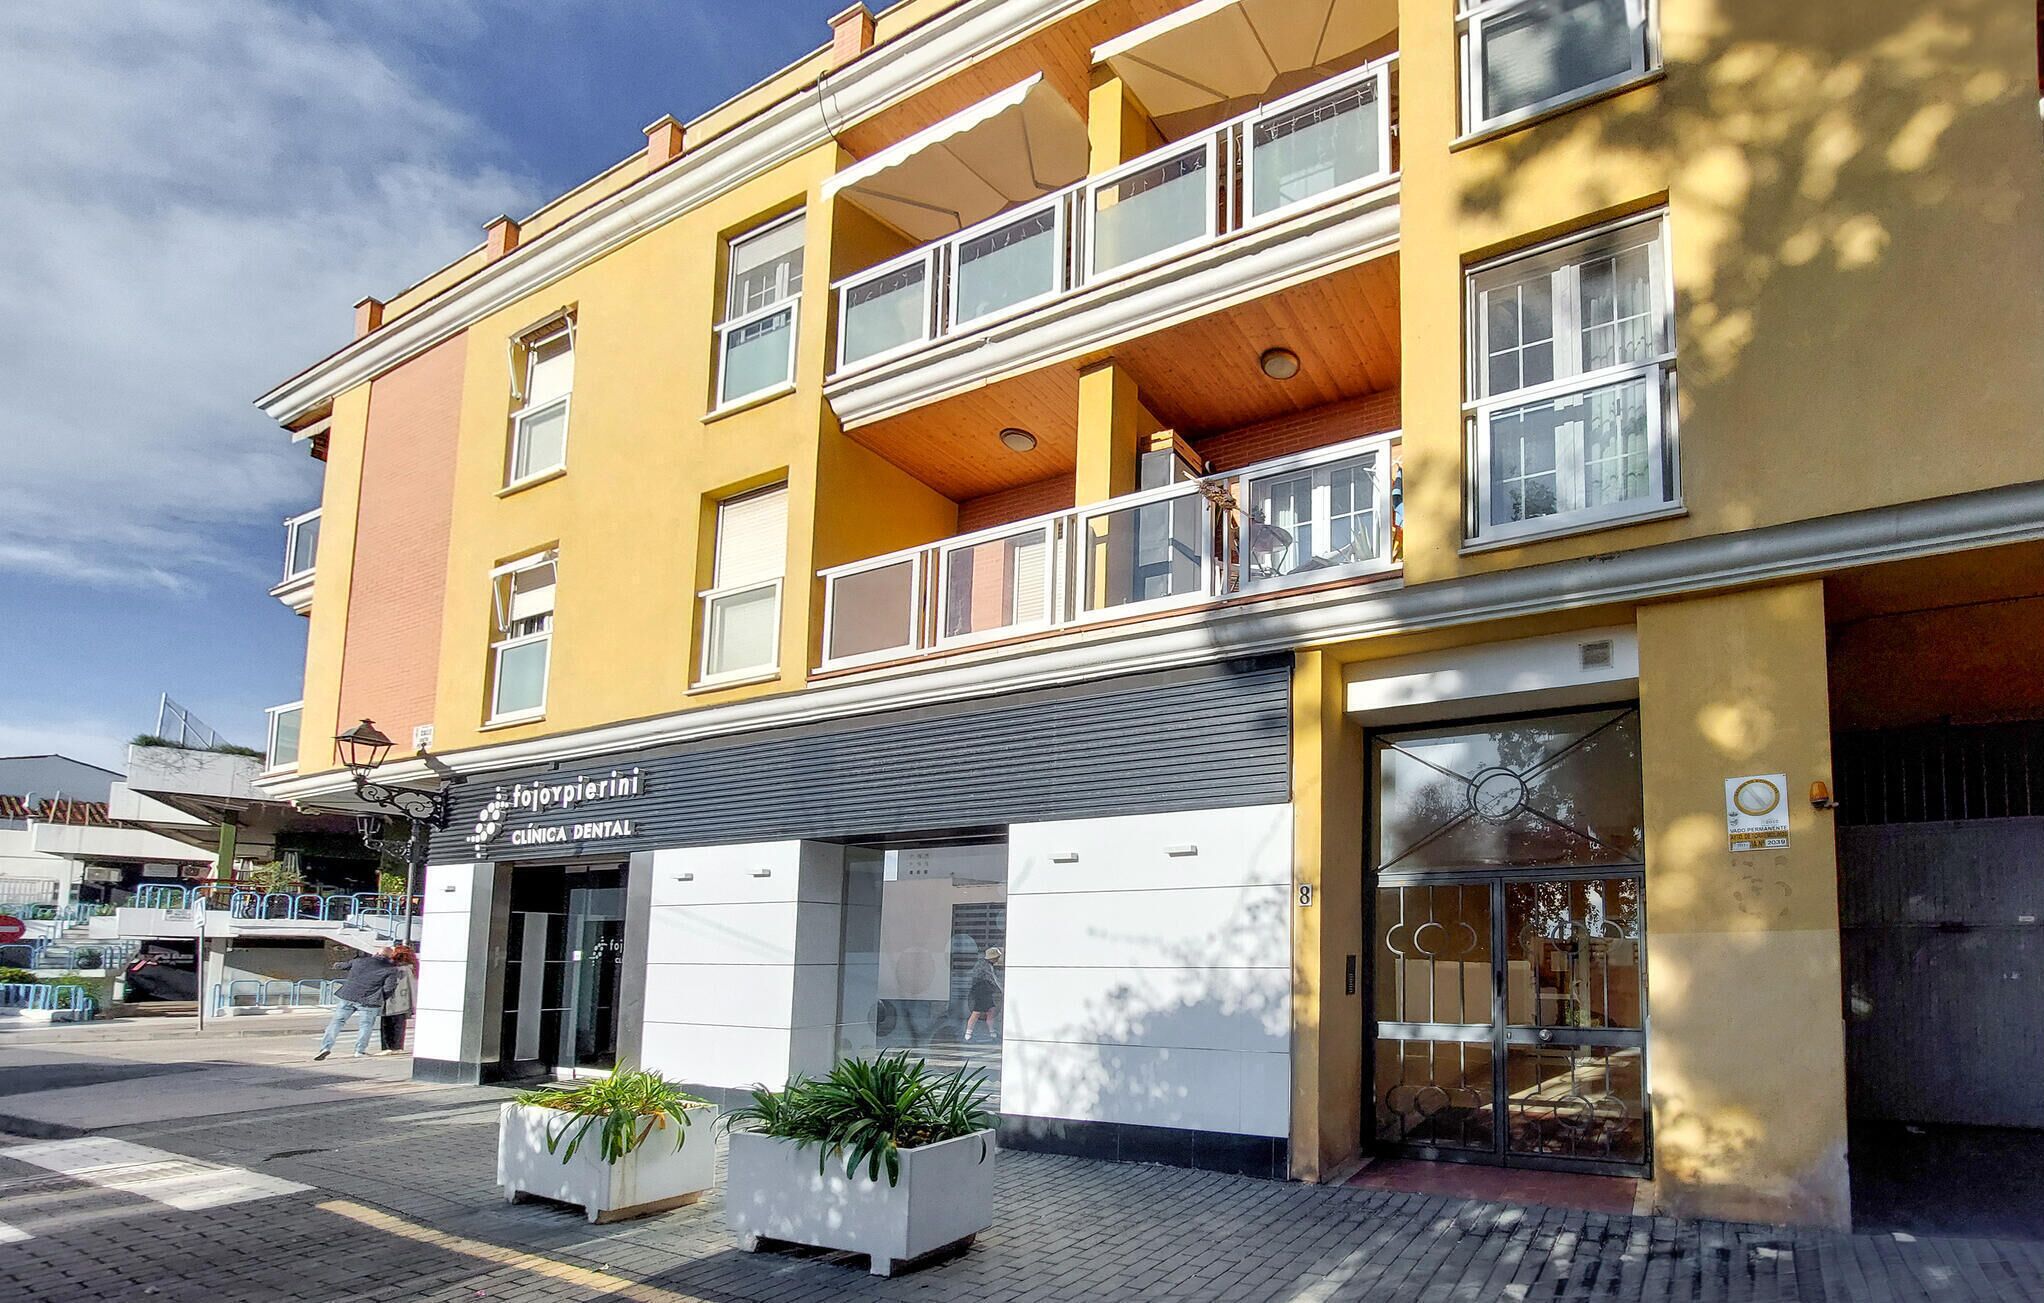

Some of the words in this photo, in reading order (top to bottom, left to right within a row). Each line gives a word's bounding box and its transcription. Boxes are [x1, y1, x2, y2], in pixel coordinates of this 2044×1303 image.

[511, 823, 567, 845] CLÍNICA
[573, 819, 632, 841] DENTAL
[1300, 886, 1310, 904] 8
